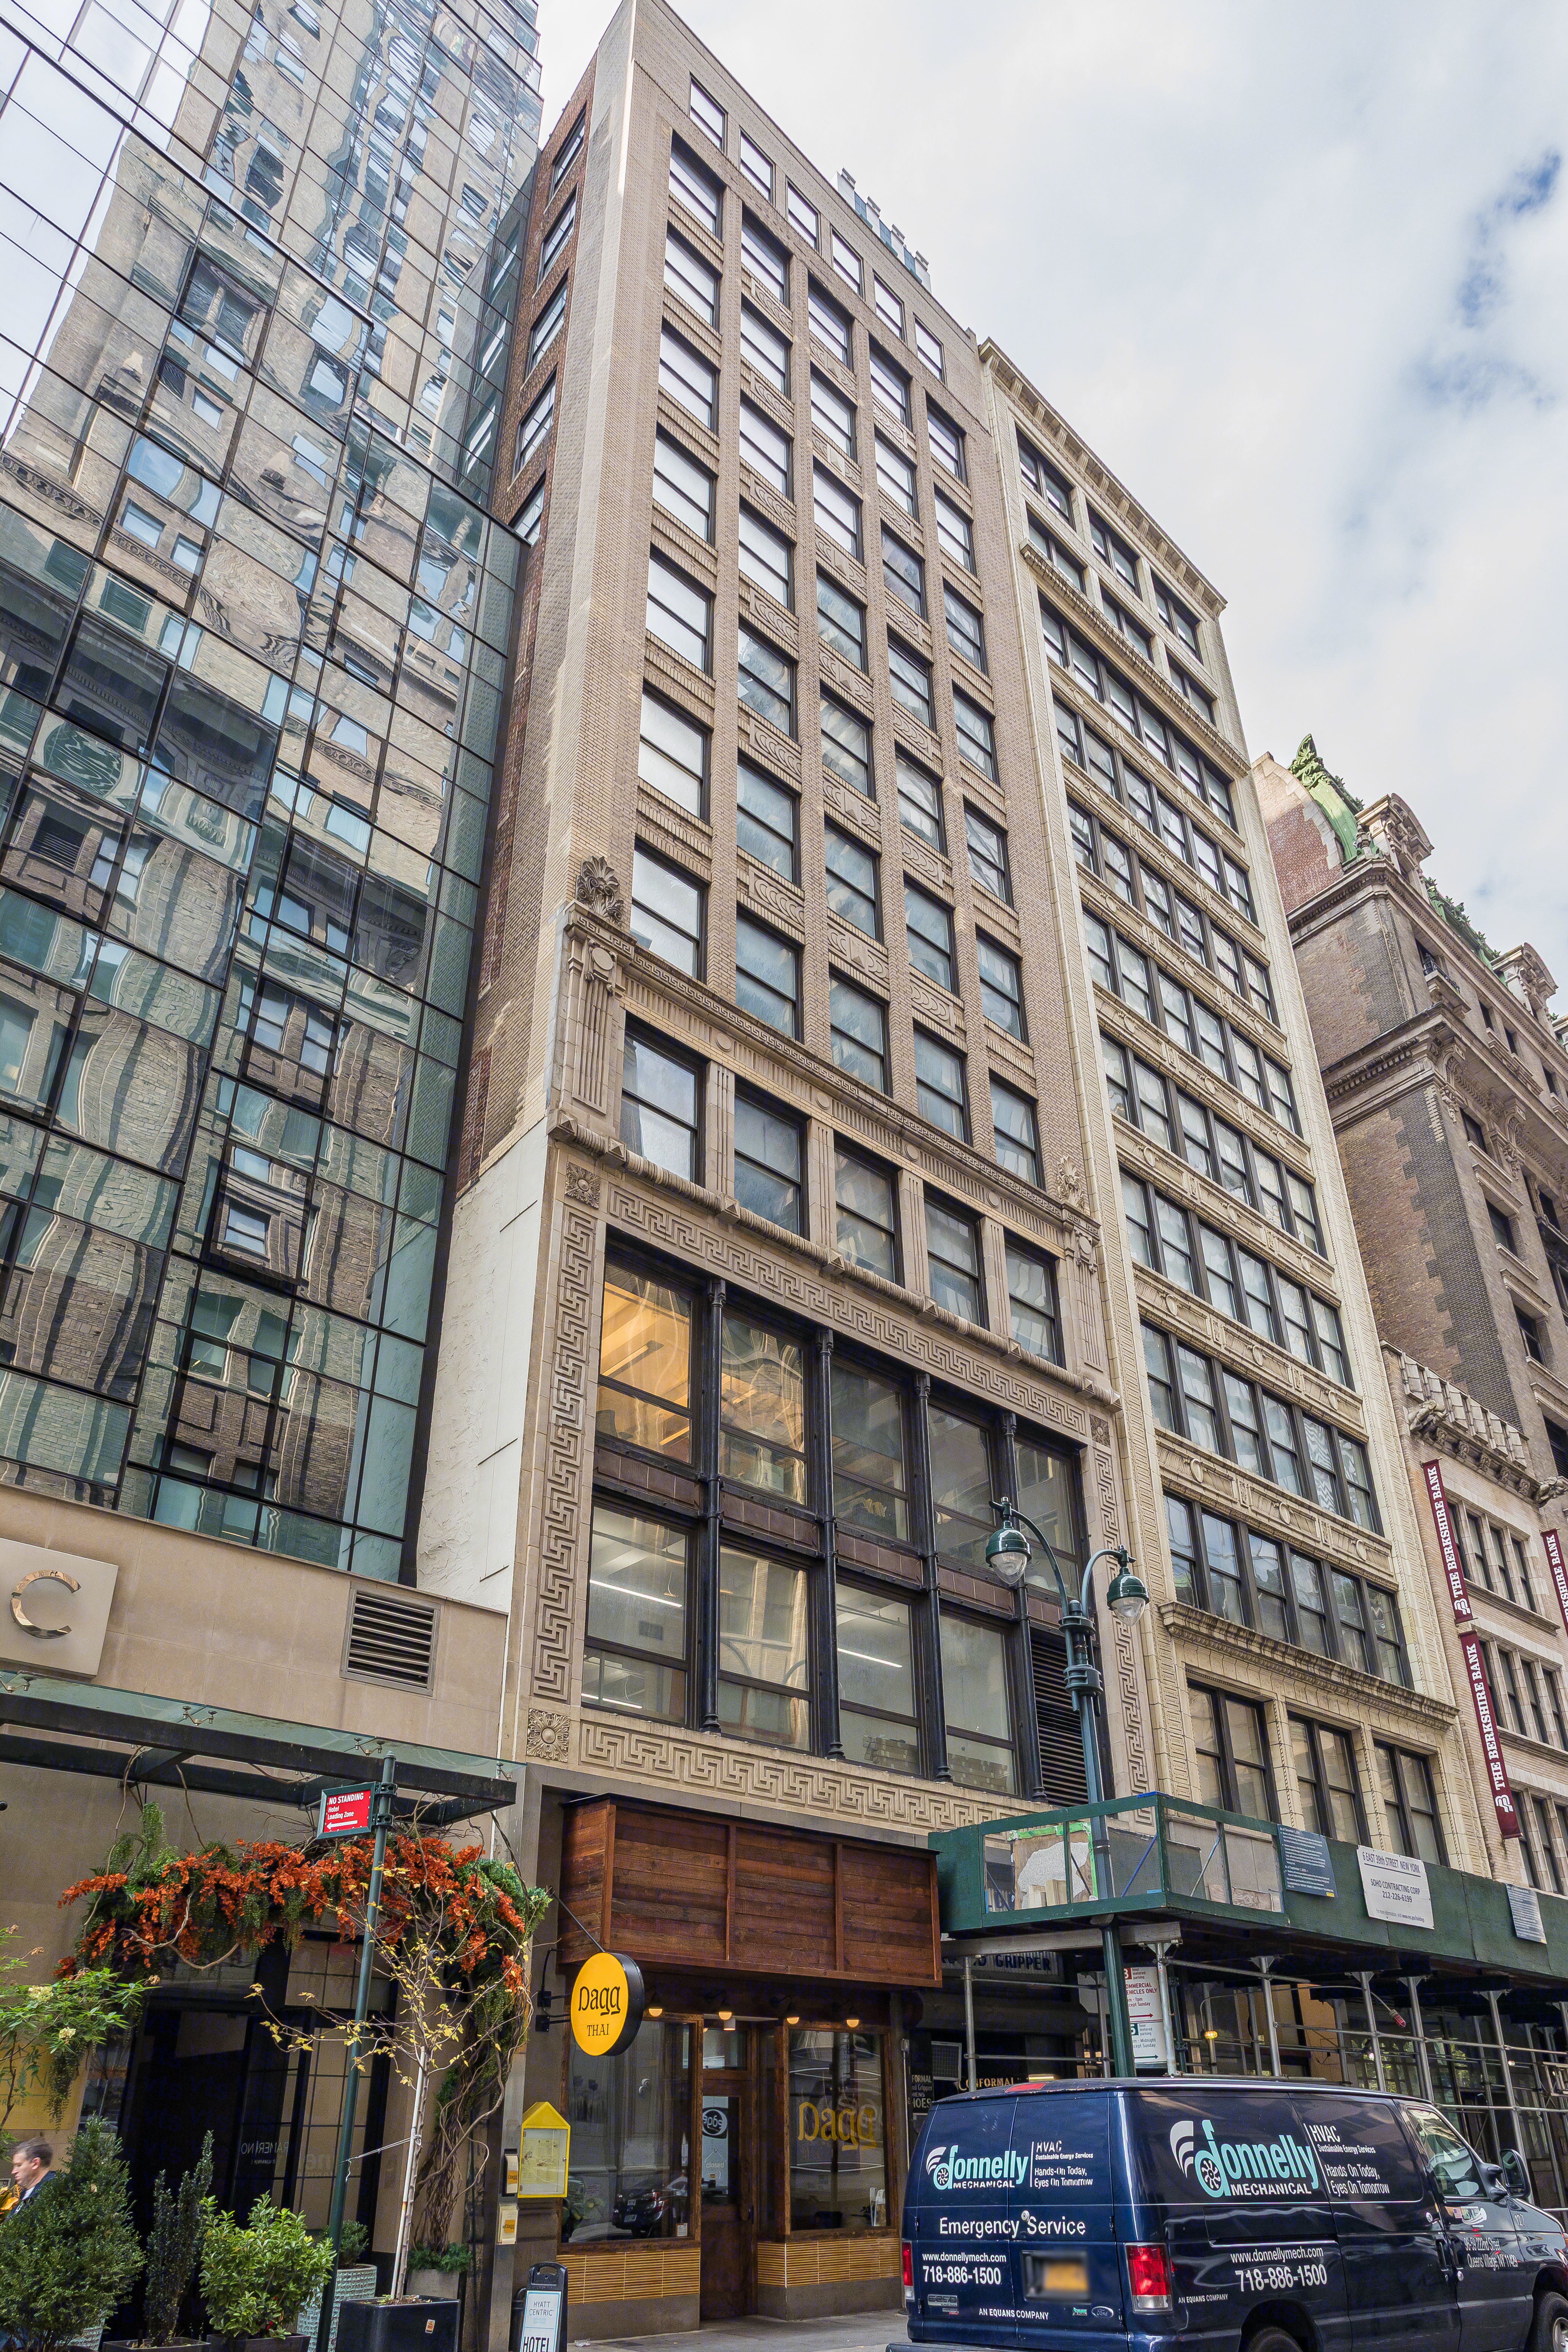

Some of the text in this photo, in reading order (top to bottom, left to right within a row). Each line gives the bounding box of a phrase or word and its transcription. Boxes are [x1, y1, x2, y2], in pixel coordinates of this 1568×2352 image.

[1427, 1465, 1442, 1500] BANK
[1435, 1500, 1457, 1572] BERKSHIRE
[1546, 1534, 1561, 1566] BANK
[1449, 1571, 1464, 1598] THE
[1466, 1643, 1482, 1681] BANK
[1474, 1682, 1499, 1761] BERKSHIRE
[1490, 1761, 1506, 1791] THE
[329, 1792, 364, 1805] NO STANDING
[1362, 1851, 1420, 1873] 6 EAST 39th STREET NEW YORK
[1370, 1878, 1420, 1895] SOHO CONTRACTING CORP
[1382, 1891, 1412, 1903] 212-226-6199
[995, 1953, 1051, 1971] GRIPPER
[578, 1985, 621, 2016] Dagg
[586, 2023, 609, 2037] THAI
[797, 2101, 877, 2151] Dagg
[1311, 2125, 1340, 2143] HVAC
[1036, 2140, 1062, 2153] HVAC
[1317, 2143, 1376, 2155] Sustainable Energy Services
[1194, 2119, 1319, 2198] donnelly
[933, 2145, 1029, 2190] donnelly
[1035, 2165, 1087, 2177] Hands-On Today,
[1348, 2164, 1357, 2177] On
[1357, 2164, 1380, 2180] Today,
[953, 2180, 1015, 2189] MECHANICAL
[1035, 2177, 1093, 2189] Eyes On Tomorrow
[1231, 2183, 1312, 2197] MECHANICAL
[1331, 2180, 1390, 2197] Eyes On Tomorrow
[939, 2216, 1086, 2239] Emergency Service
[1514, 2213, 1525, 2227] 127
[1463, 2237, 1501, 2251] 96-59 222nd Street
[922, 2252, 1007, 2264] www.donnellymech.com
[1230, 2246, 1324, 2263] www.donnellymech.com
[1467, 2253, 1518, 2271] Queens Village, NY 11429
[923, 2265, 1002, 2285] 718-886-1500
[1235, 2264, 1327, 2292] 718-886-1500
[1186, 2295, 1205, 2303] EQUANS
[1206, 2294, 1228, 2302] COMPANY
[989, 2308, 1015, 2318] EQUANS
[1016, 2310, 1049, 2320] COMPANY
[523, 2336, 552, 2352] HOTEL
